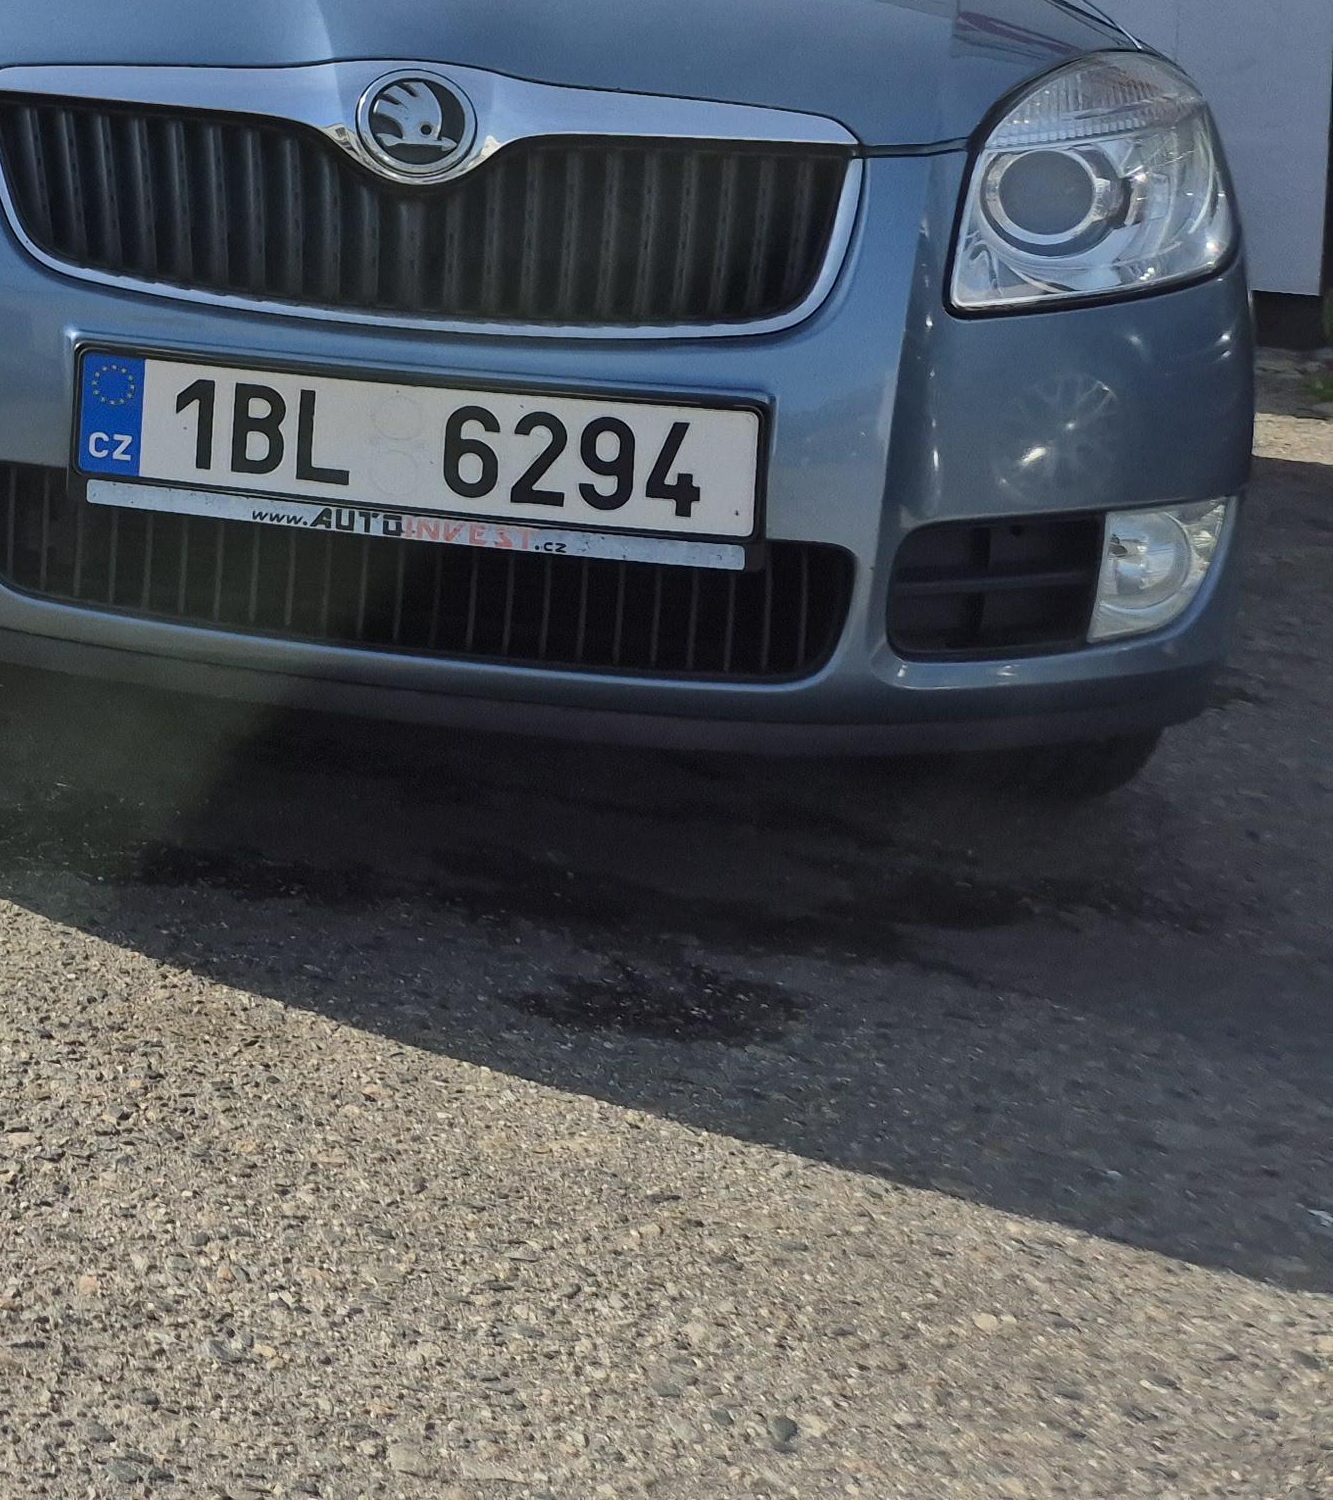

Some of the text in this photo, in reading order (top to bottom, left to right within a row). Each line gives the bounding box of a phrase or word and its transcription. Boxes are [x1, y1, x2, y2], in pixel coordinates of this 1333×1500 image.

[88, 431, 133, 461] CZ
[175, 379, 701, 518] 1BL 6294
